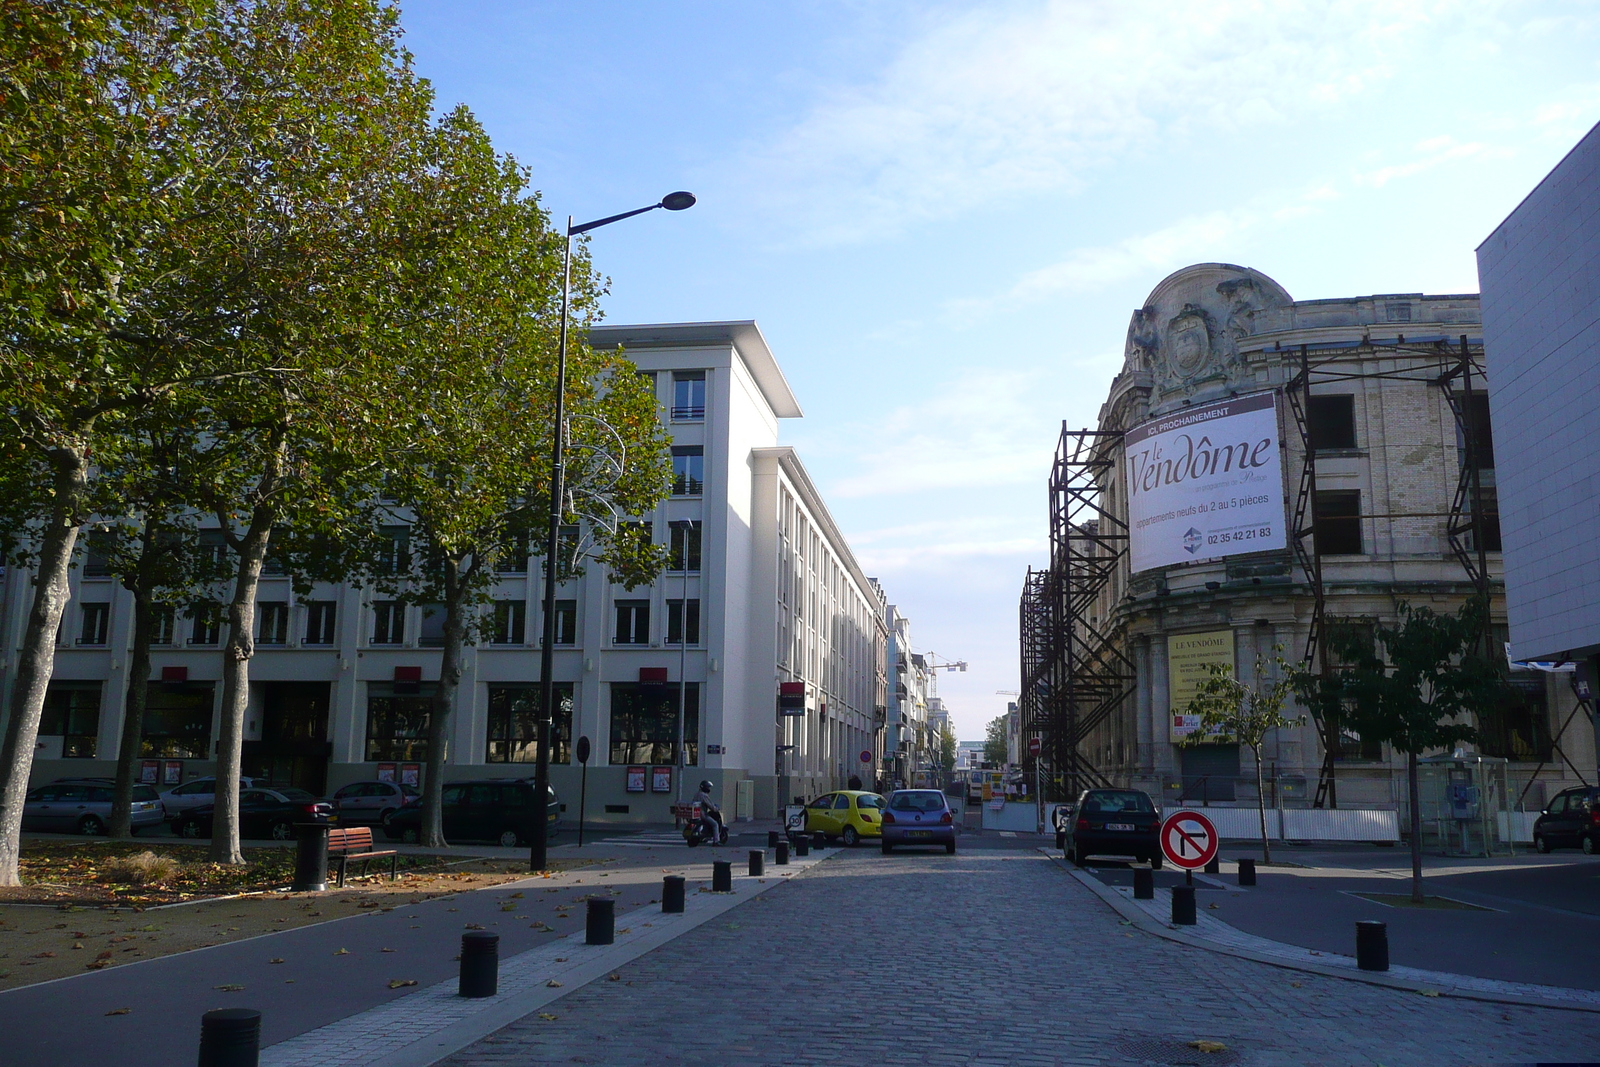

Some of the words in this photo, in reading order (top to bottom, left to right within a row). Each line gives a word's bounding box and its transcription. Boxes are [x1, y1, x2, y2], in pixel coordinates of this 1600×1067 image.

[1148, 426, 1159, 436] ICI,
[1159, 408, 1229, 434] PROCHAINEMENT
[1152, 442, 1162, 460] le
[1130, 434, 1271, 496] Vendôme
[1202, 481, 1230, 492] programme
[1136, 511, 1175, 529] appartements
[1177, 504, 1196, 518] neufs
[1198, 501, 1208, 513] du
[1210, 499, 1216, 511] 2
[1218, 500, 1228, 510] au
[1231, 498, 1236, 508] 5
[1239, 494, 1269, 509] pièces
[1208, 535, 1218, 544] 02
[1220, 533, 1230, 542] 35
[1233, 531, 1243, 540] 42
[1246, 529, 1256, 539] 21
[1259, 527, 1271, 537] 83
[1187, 638, 1224, 648] VENDÔME
